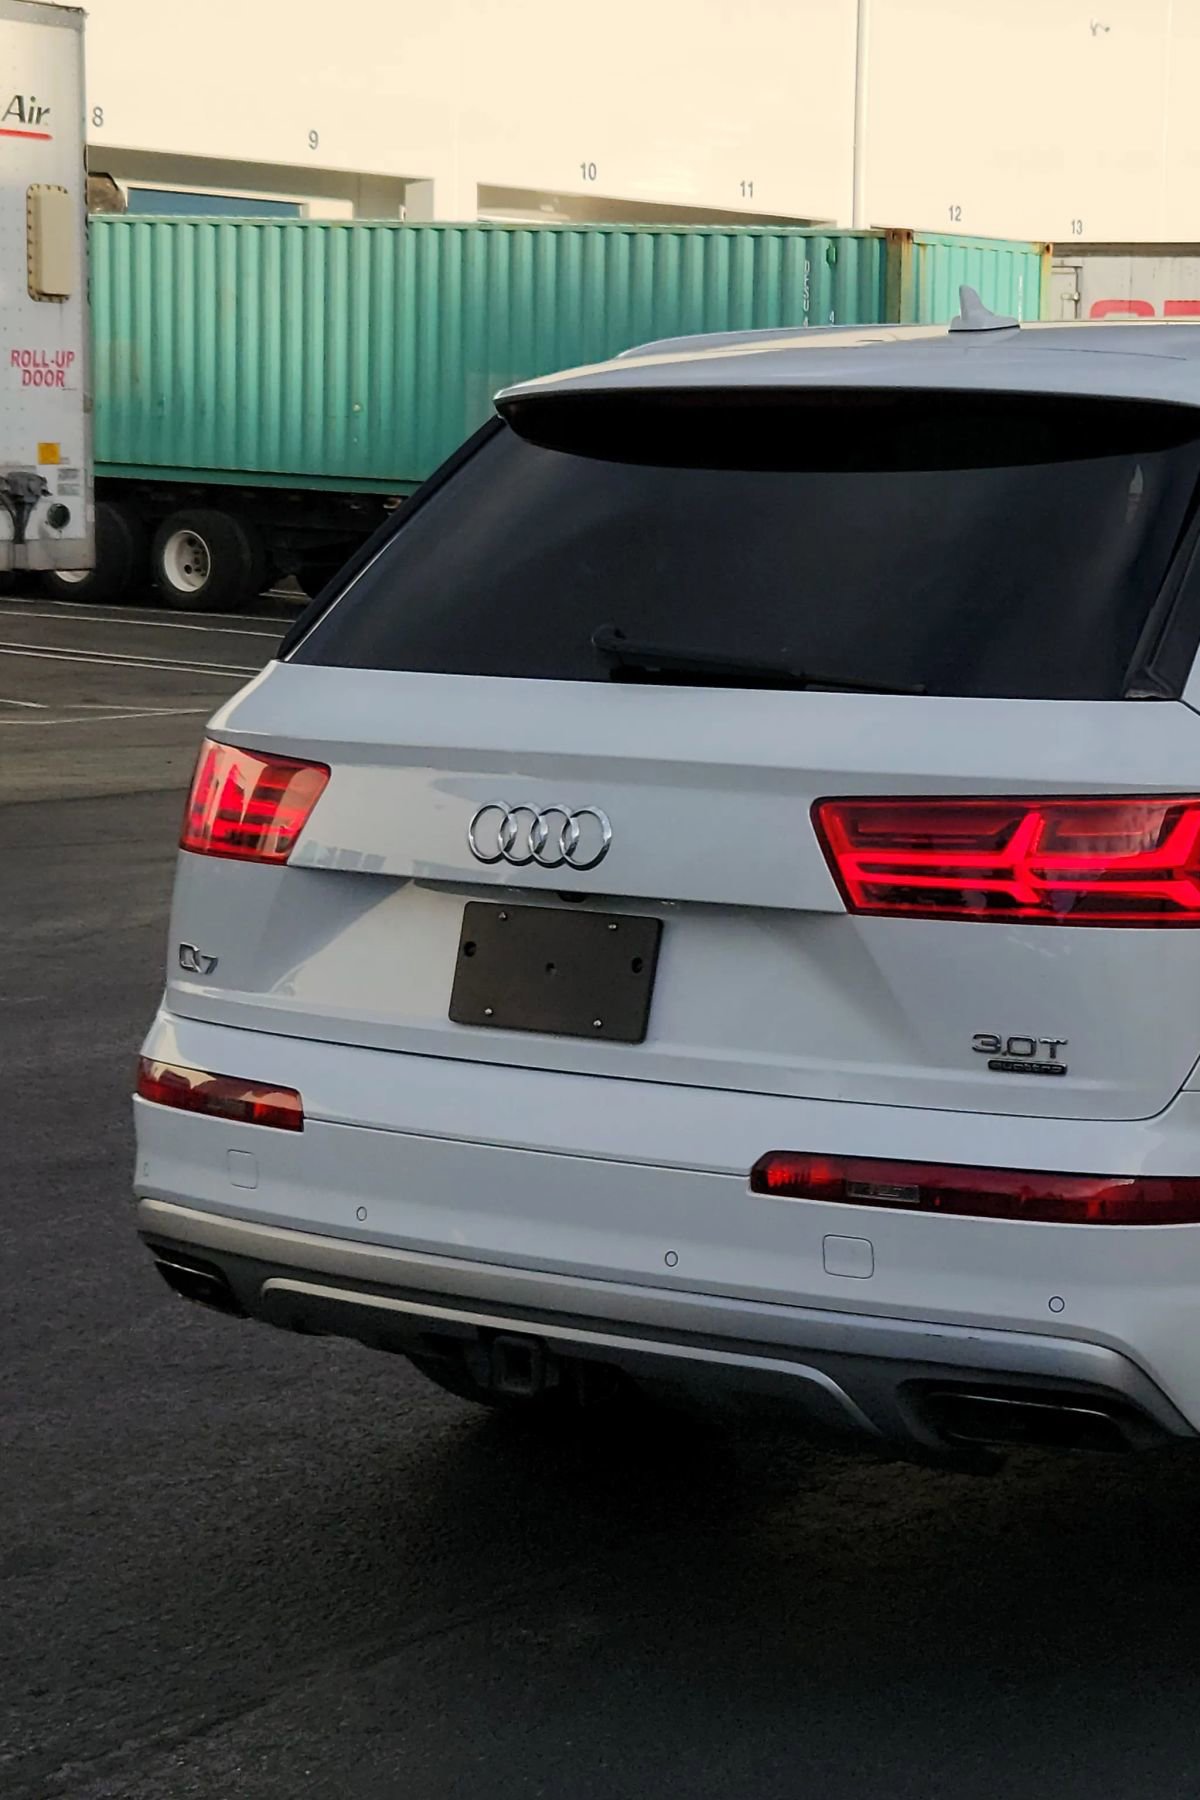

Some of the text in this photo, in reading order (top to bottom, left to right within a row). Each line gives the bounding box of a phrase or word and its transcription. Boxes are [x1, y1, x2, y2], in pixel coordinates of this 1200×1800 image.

[1, 94, 51, 126] Air
[92, 106, 104, 127] 8
[308, 129, 319, 150] 9
[579, 161, 597, 181] 10
[739, 180, 753, 198] 11
[948, 204, 962, 222] 12
[1071, 218, 1083, 235] 13
[11, 350, 75, 368] ROLL-UP
[22, 369, 65, 387] DOOR
[179, 941, 219, 975] Q7
